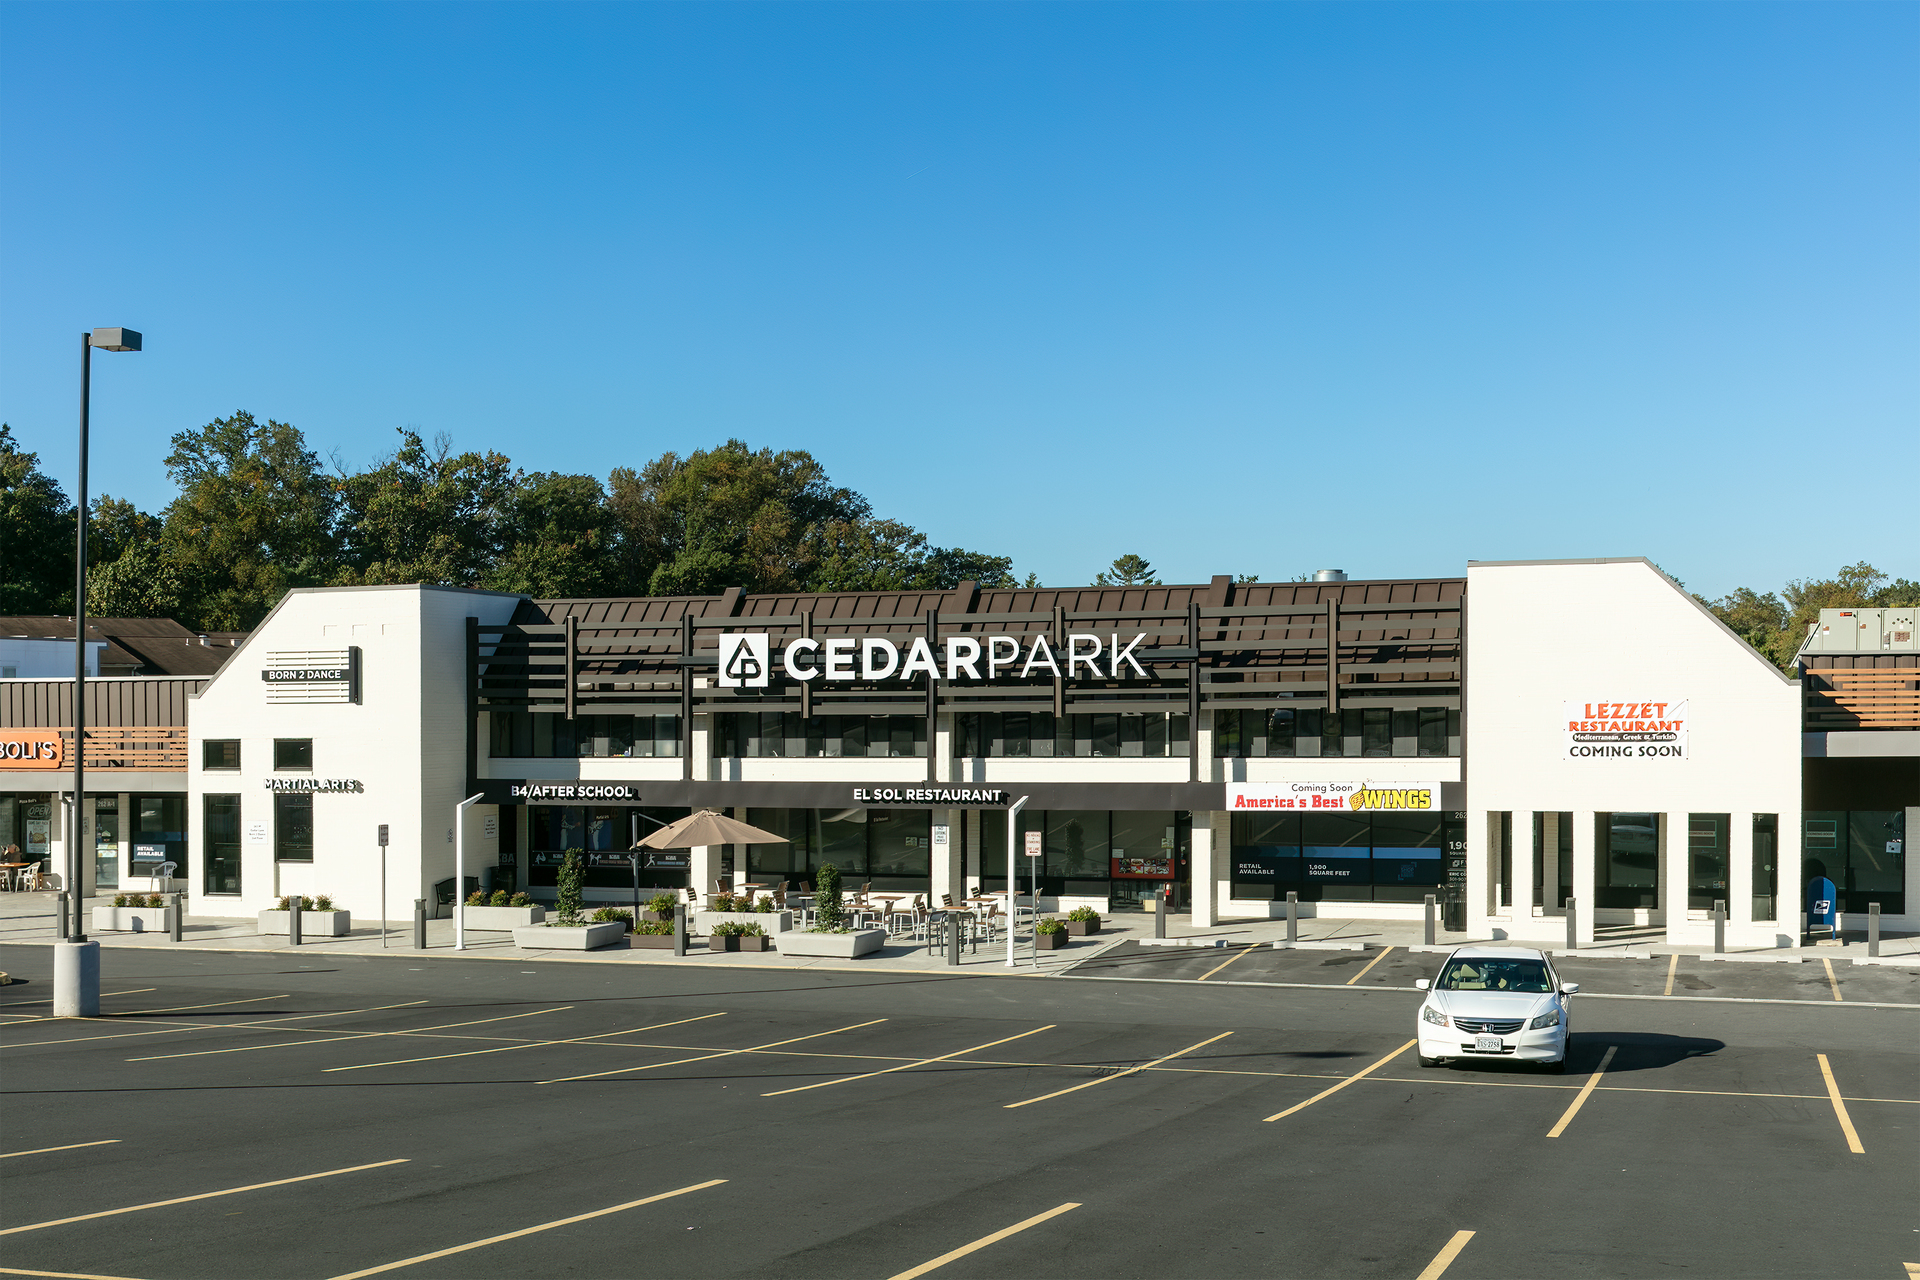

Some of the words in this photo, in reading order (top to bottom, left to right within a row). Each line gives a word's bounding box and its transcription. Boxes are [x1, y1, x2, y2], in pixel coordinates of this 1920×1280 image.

[783, 632, 1148, 681] CEDARPARK
[269, 671, 297, 680] BORN
[299, 671, 305, 679] 2
[307, 670, 341, 679] DANCE
[1585, 703, 1669, 719] LEZZET
[1569, 720, 1684, 732] RESTAURANT
[1574, 733, 1621, 741] Mediterranean,
[1622, 733, 1642, 741] Greek
[1569, 746, 1633, 757] COMING
[1638, 746, 1682, 757] SOON
[265, 779, 319, 790] MARTIAL
[322, 780, 356, 790] ARTS
[1291, 783, 1327, 794] Coming
[1329, 784, 1353, 792] Soon
[511, 784, 574, 798] B4/AFTER
[578, 785, 632, 797] SCHOOL
[853, 788, 871, 800] EL
[873, 788, 903, 800] SOL
[906, 788, 1002, 801] RESTAURANT
[1234, 794, 1307, 809] America's
[1311, 794, 1344, 809] Best
[1362, 789, 1431, 809] WINGS
[29, 806, 50, 816] OPEN
